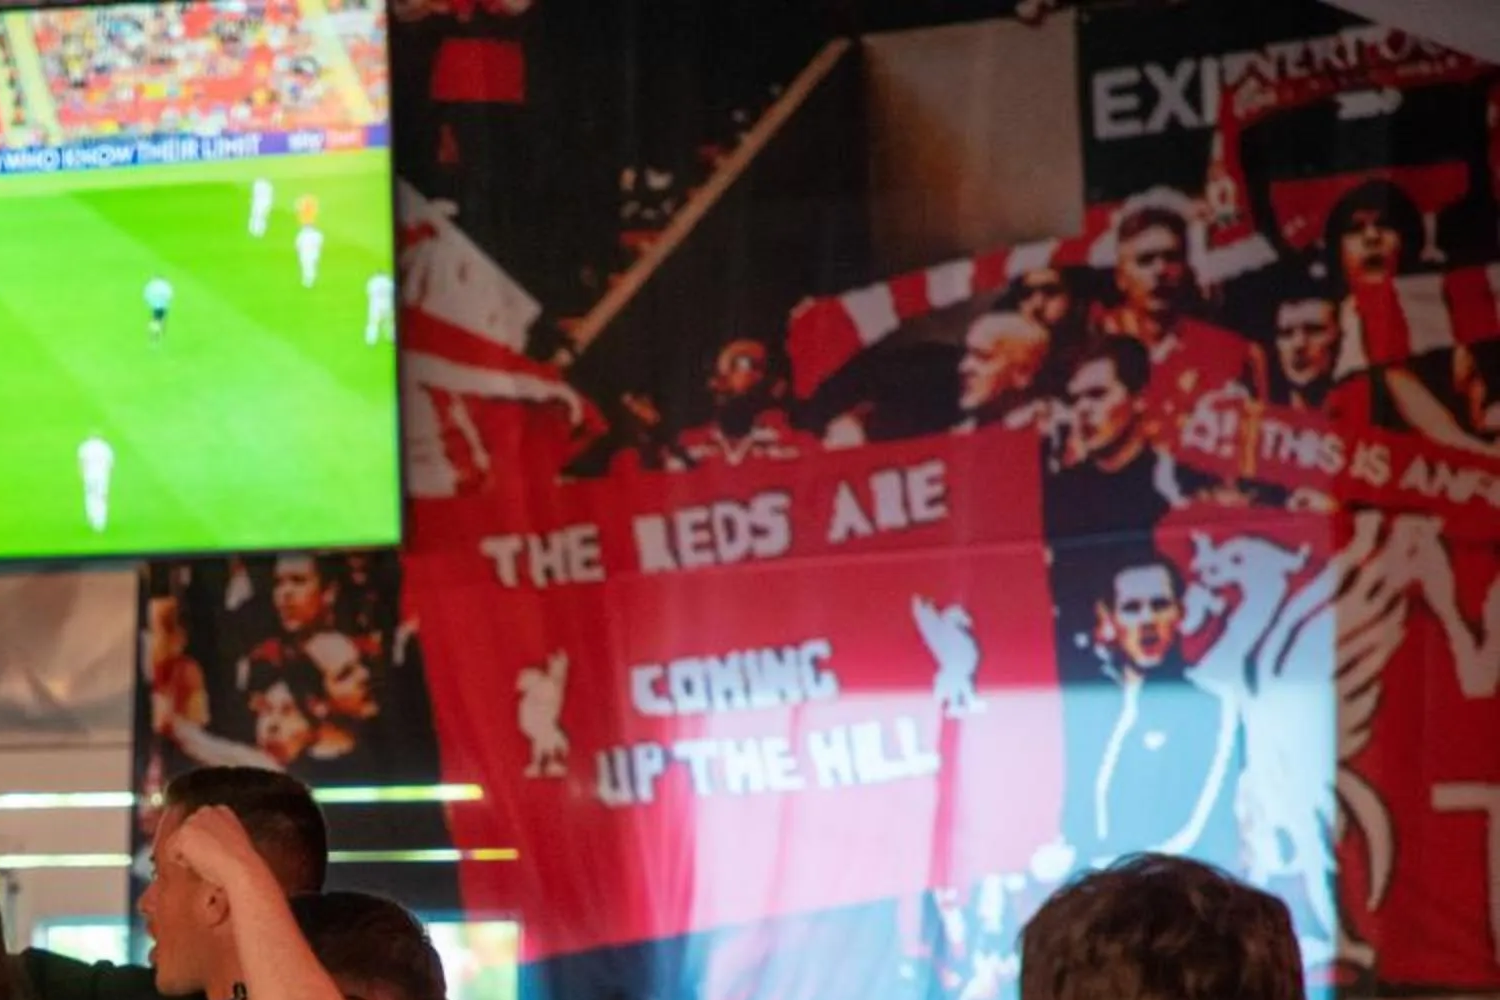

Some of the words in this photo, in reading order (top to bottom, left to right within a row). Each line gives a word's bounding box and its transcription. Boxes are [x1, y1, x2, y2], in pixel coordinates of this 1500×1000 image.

[1092, 56, 1222, 141] EXI
[1259, 417, 1345, 475] THIS
[1351, 440, 1392, 487] IS
[479, 524, 606, 589] THE
[632, 491, 792, 574] REDS
[827, 459, 949, 543] ARE
[629, 638, 840, 717] COMING
[596, 741, 666, 808] UP
[670, 735, 806, 798] THE
[807, 714, 941, 789] HILL
